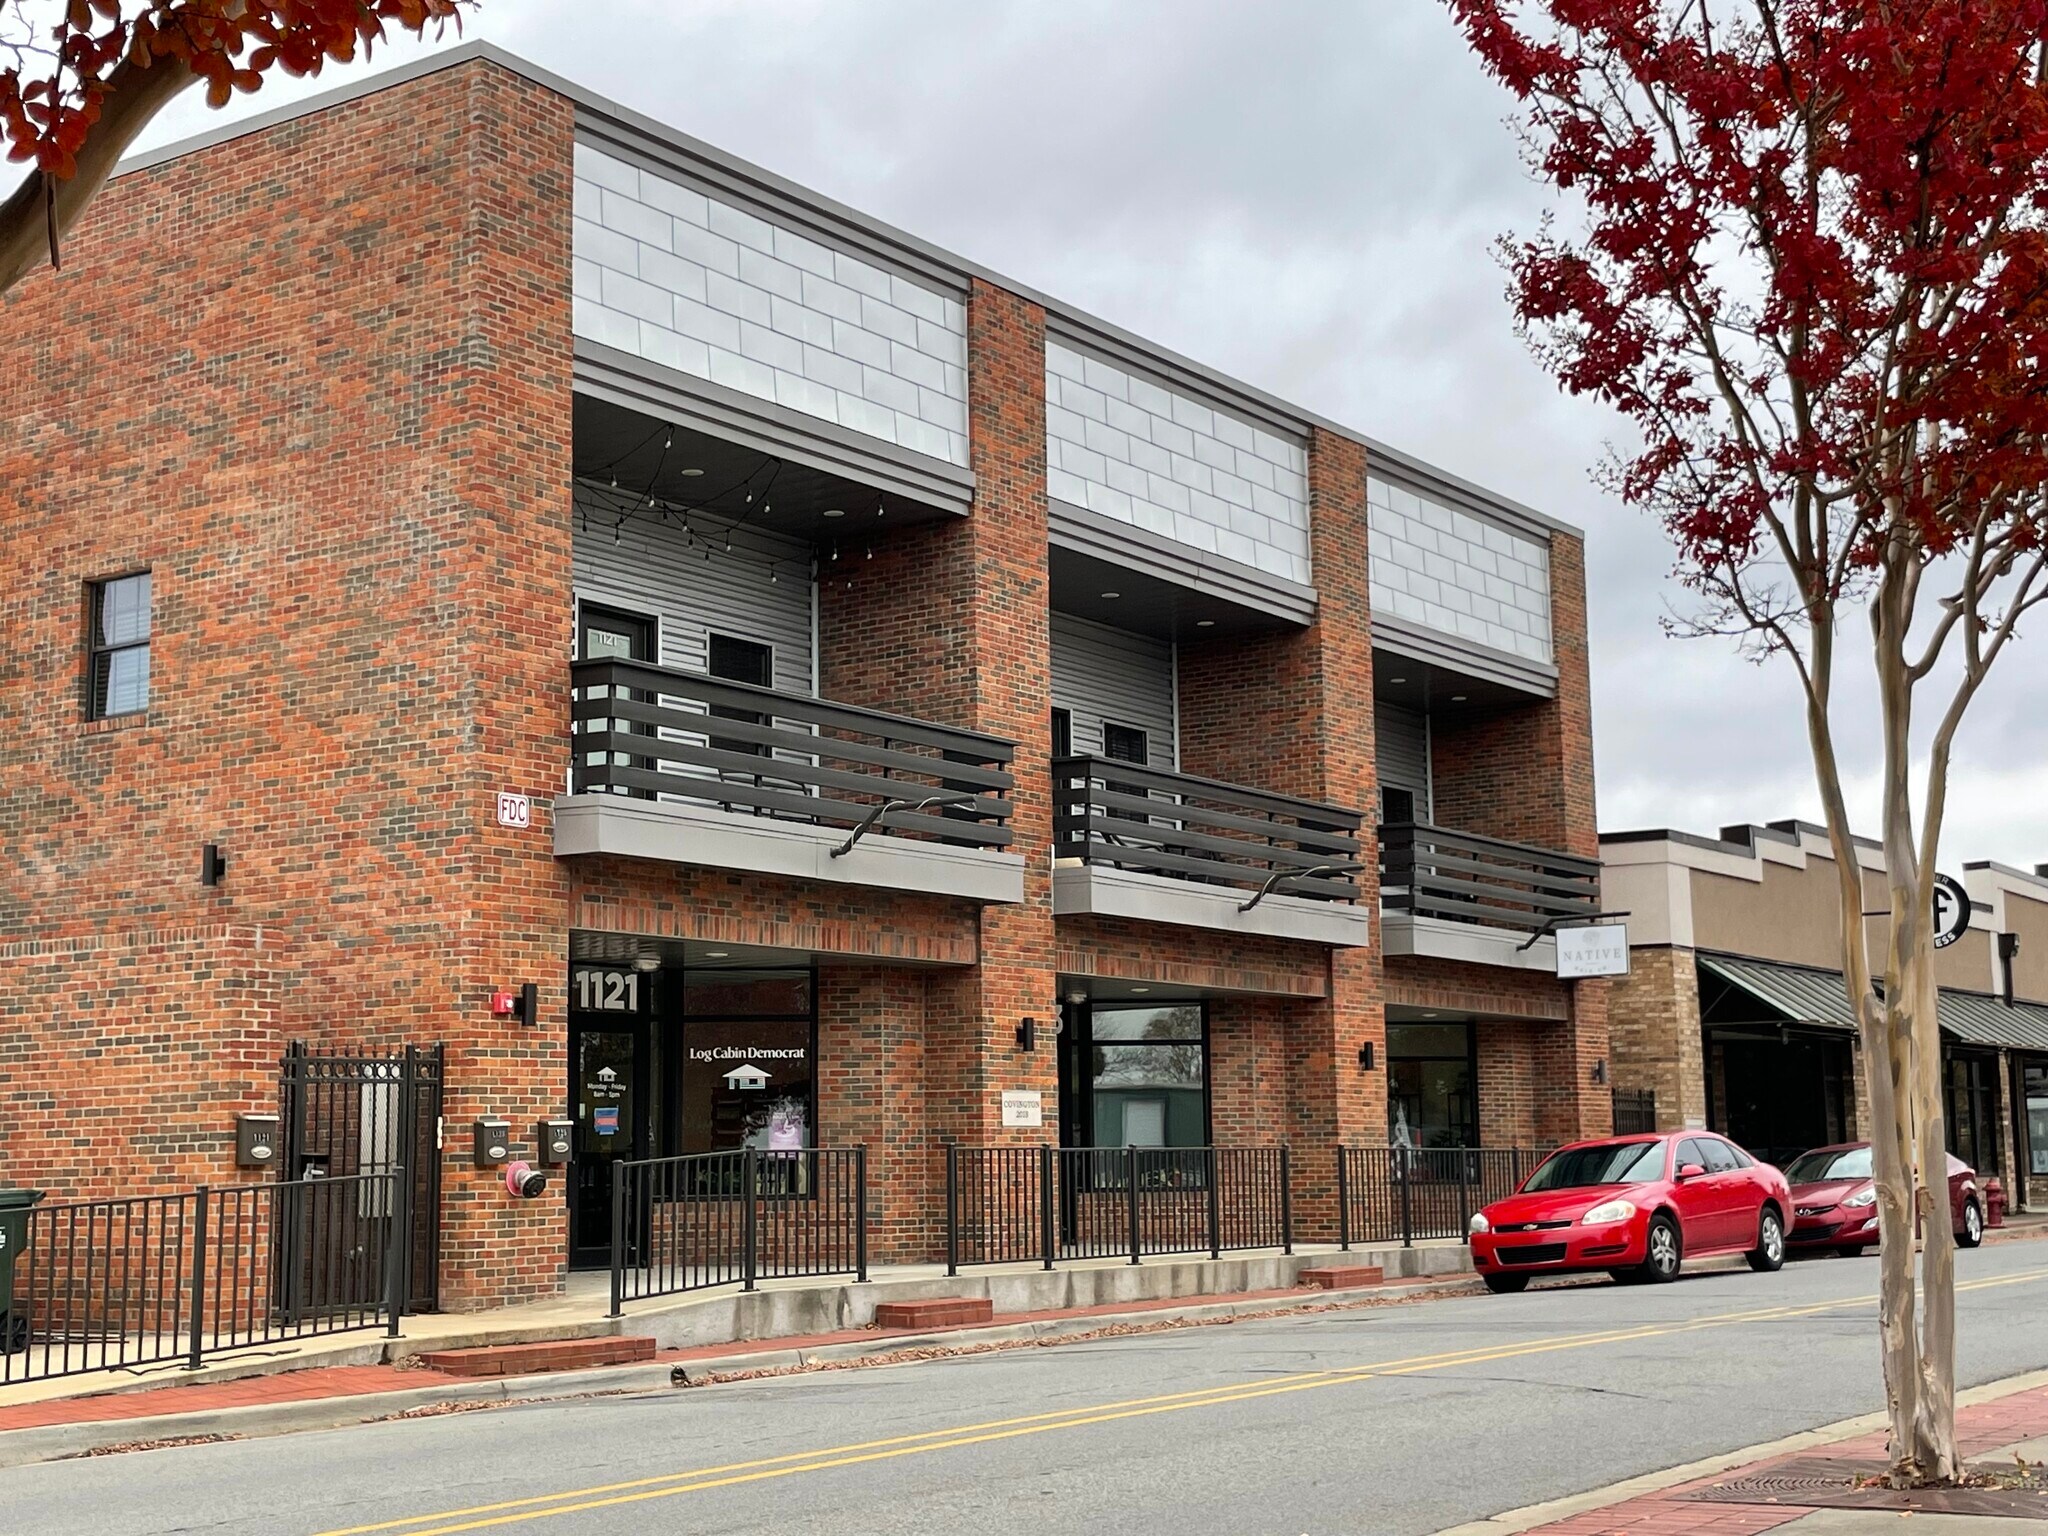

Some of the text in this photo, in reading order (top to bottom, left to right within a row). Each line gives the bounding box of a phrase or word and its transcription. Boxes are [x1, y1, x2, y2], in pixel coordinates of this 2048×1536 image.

[501, 798, 526, 822] FDC
[1935, 931, 1956, 948] ESS
[1563, 948, 1621, 961] NATIVE
[575, 970, 638, 1011] 1121
[689, 1046, 805, 1063] Log Cabin Democrat
[611, 1083, 627, 1091] Friday
[1003, 1100, 1040, 1109] COVINGTON
